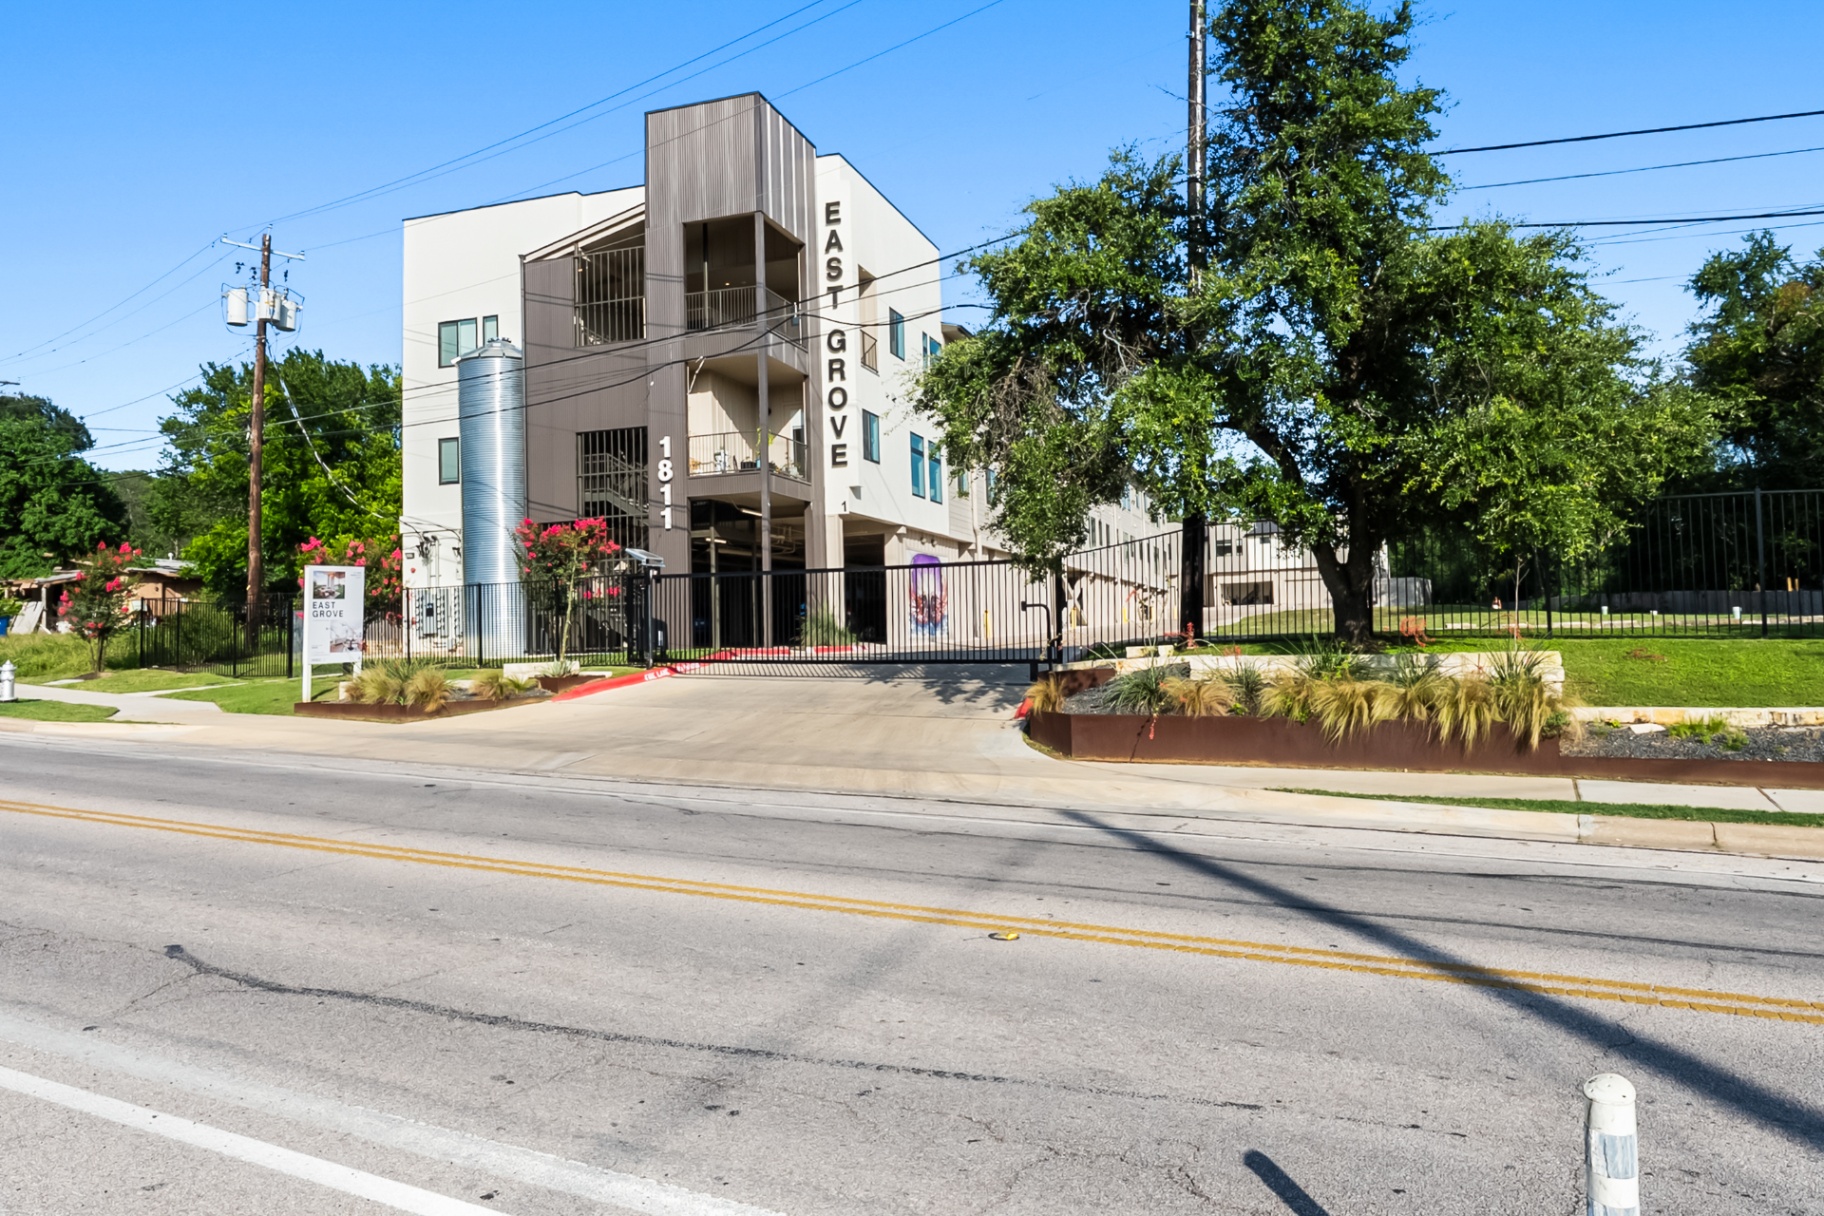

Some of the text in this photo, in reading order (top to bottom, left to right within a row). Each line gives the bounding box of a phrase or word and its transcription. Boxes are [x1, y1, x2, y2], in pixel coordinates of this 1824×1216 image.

[825, 201, 848, 467] EAST GROVE
[658, 436, 673, 530] 1811
[312, 601, 336, 609] EAST
[312, 610, 344, 618] GROVE
